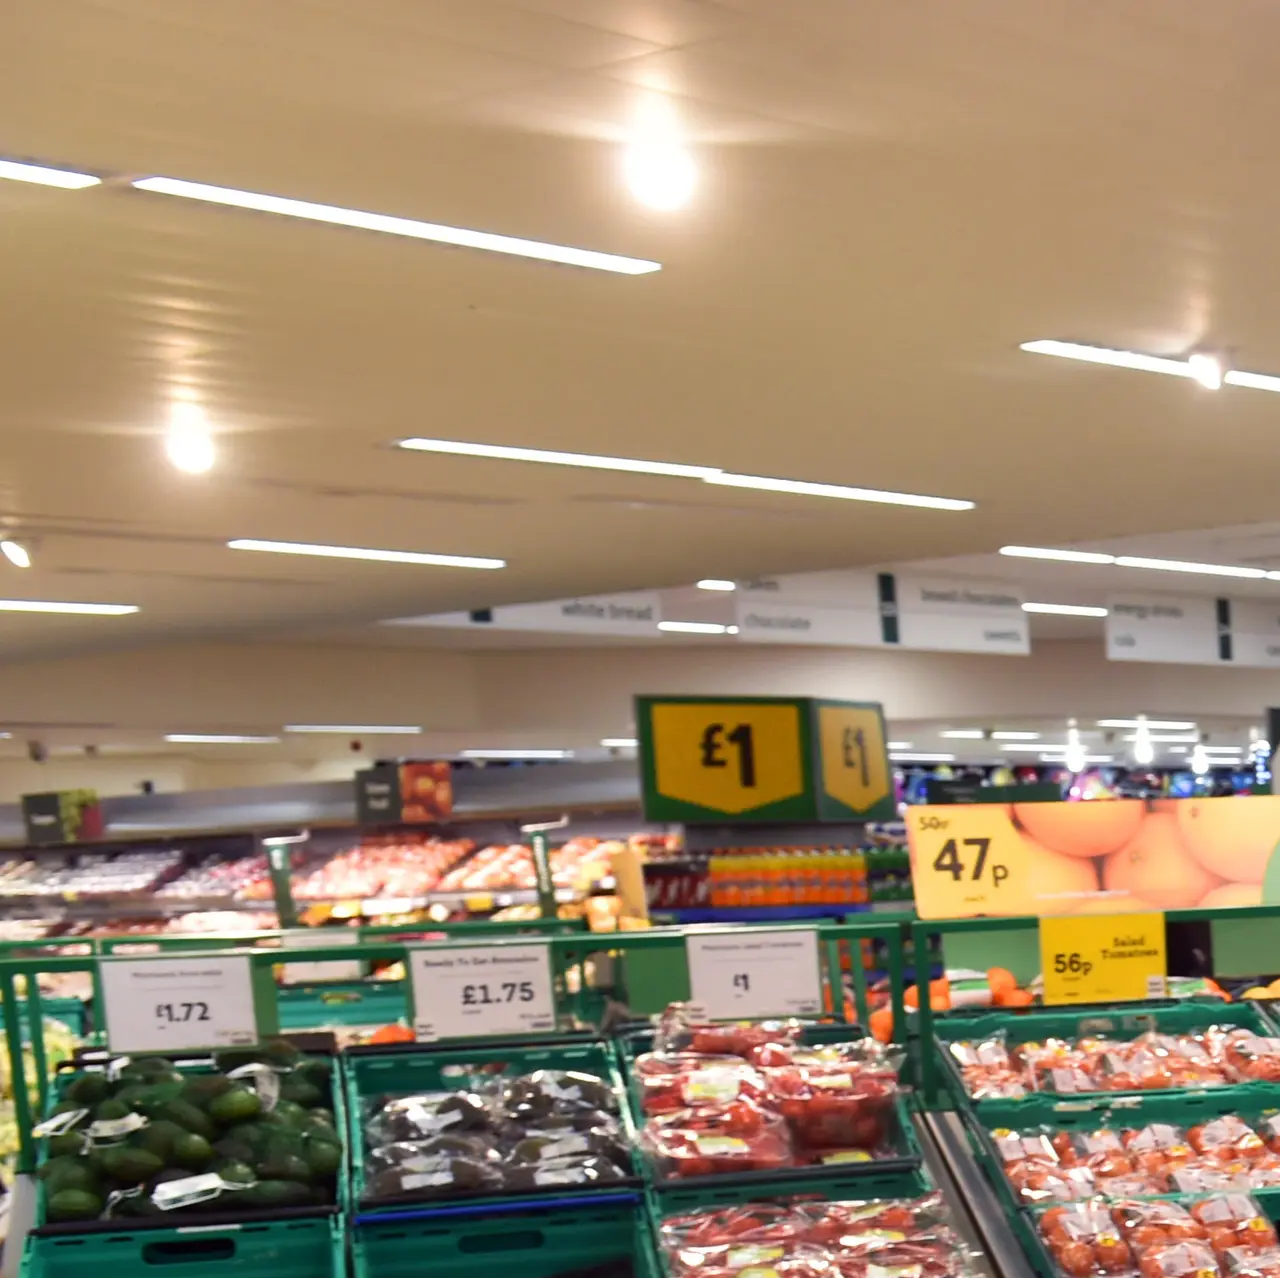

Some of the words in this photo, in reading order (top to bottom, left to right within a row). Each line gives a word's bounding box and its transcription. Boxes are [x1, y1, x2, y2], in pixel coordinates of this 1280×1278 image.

[699, 722, 758, 789] £1
[841, 724, 870, 788] £1
[932, 837, 1010, 888] 47p
[1053, 953, 1093, 976] 56p
[461, 980, 535, 1006] £1.75
[732, 972, 750, 991] £1
[156, 1001, 212, 1023] £1.72
